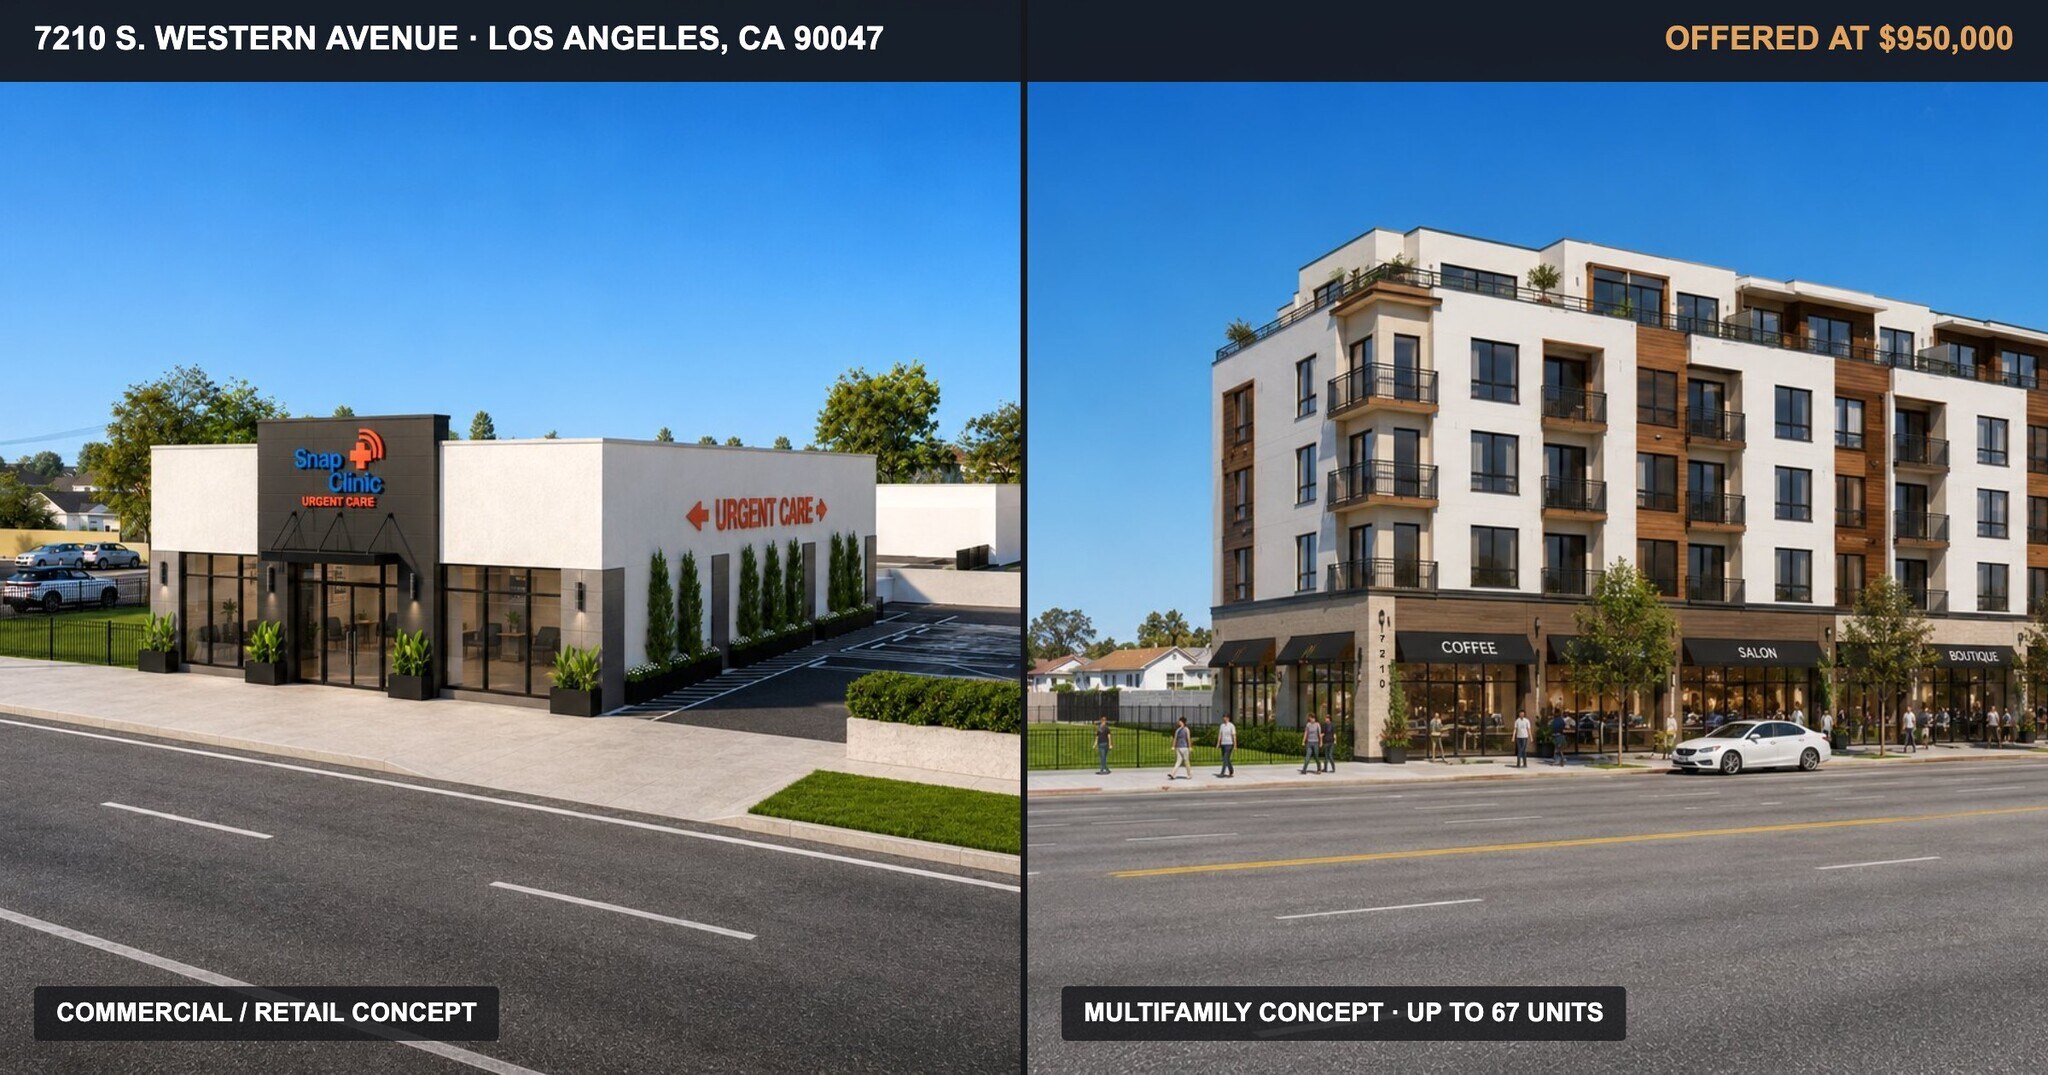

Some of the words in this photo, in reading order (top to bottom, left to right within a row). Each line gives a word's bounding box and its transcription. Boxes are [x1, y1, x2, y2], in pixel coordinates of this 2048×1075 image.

[295, 448, 344, 472] Snap
[329, 471, 383, 493] Clinic
[302, 495, 344, 507] URGENT
[346, 496, 376, 507] CARE
[715, 498, 777, 531] URGENT
[779, 496, 814, 526] CARE
[1441, 640, 1498, 655] COFFEE
[1738, 646, 1778, 659] SALON
[1949, 650, 2000, 663] BOUTIQUE
